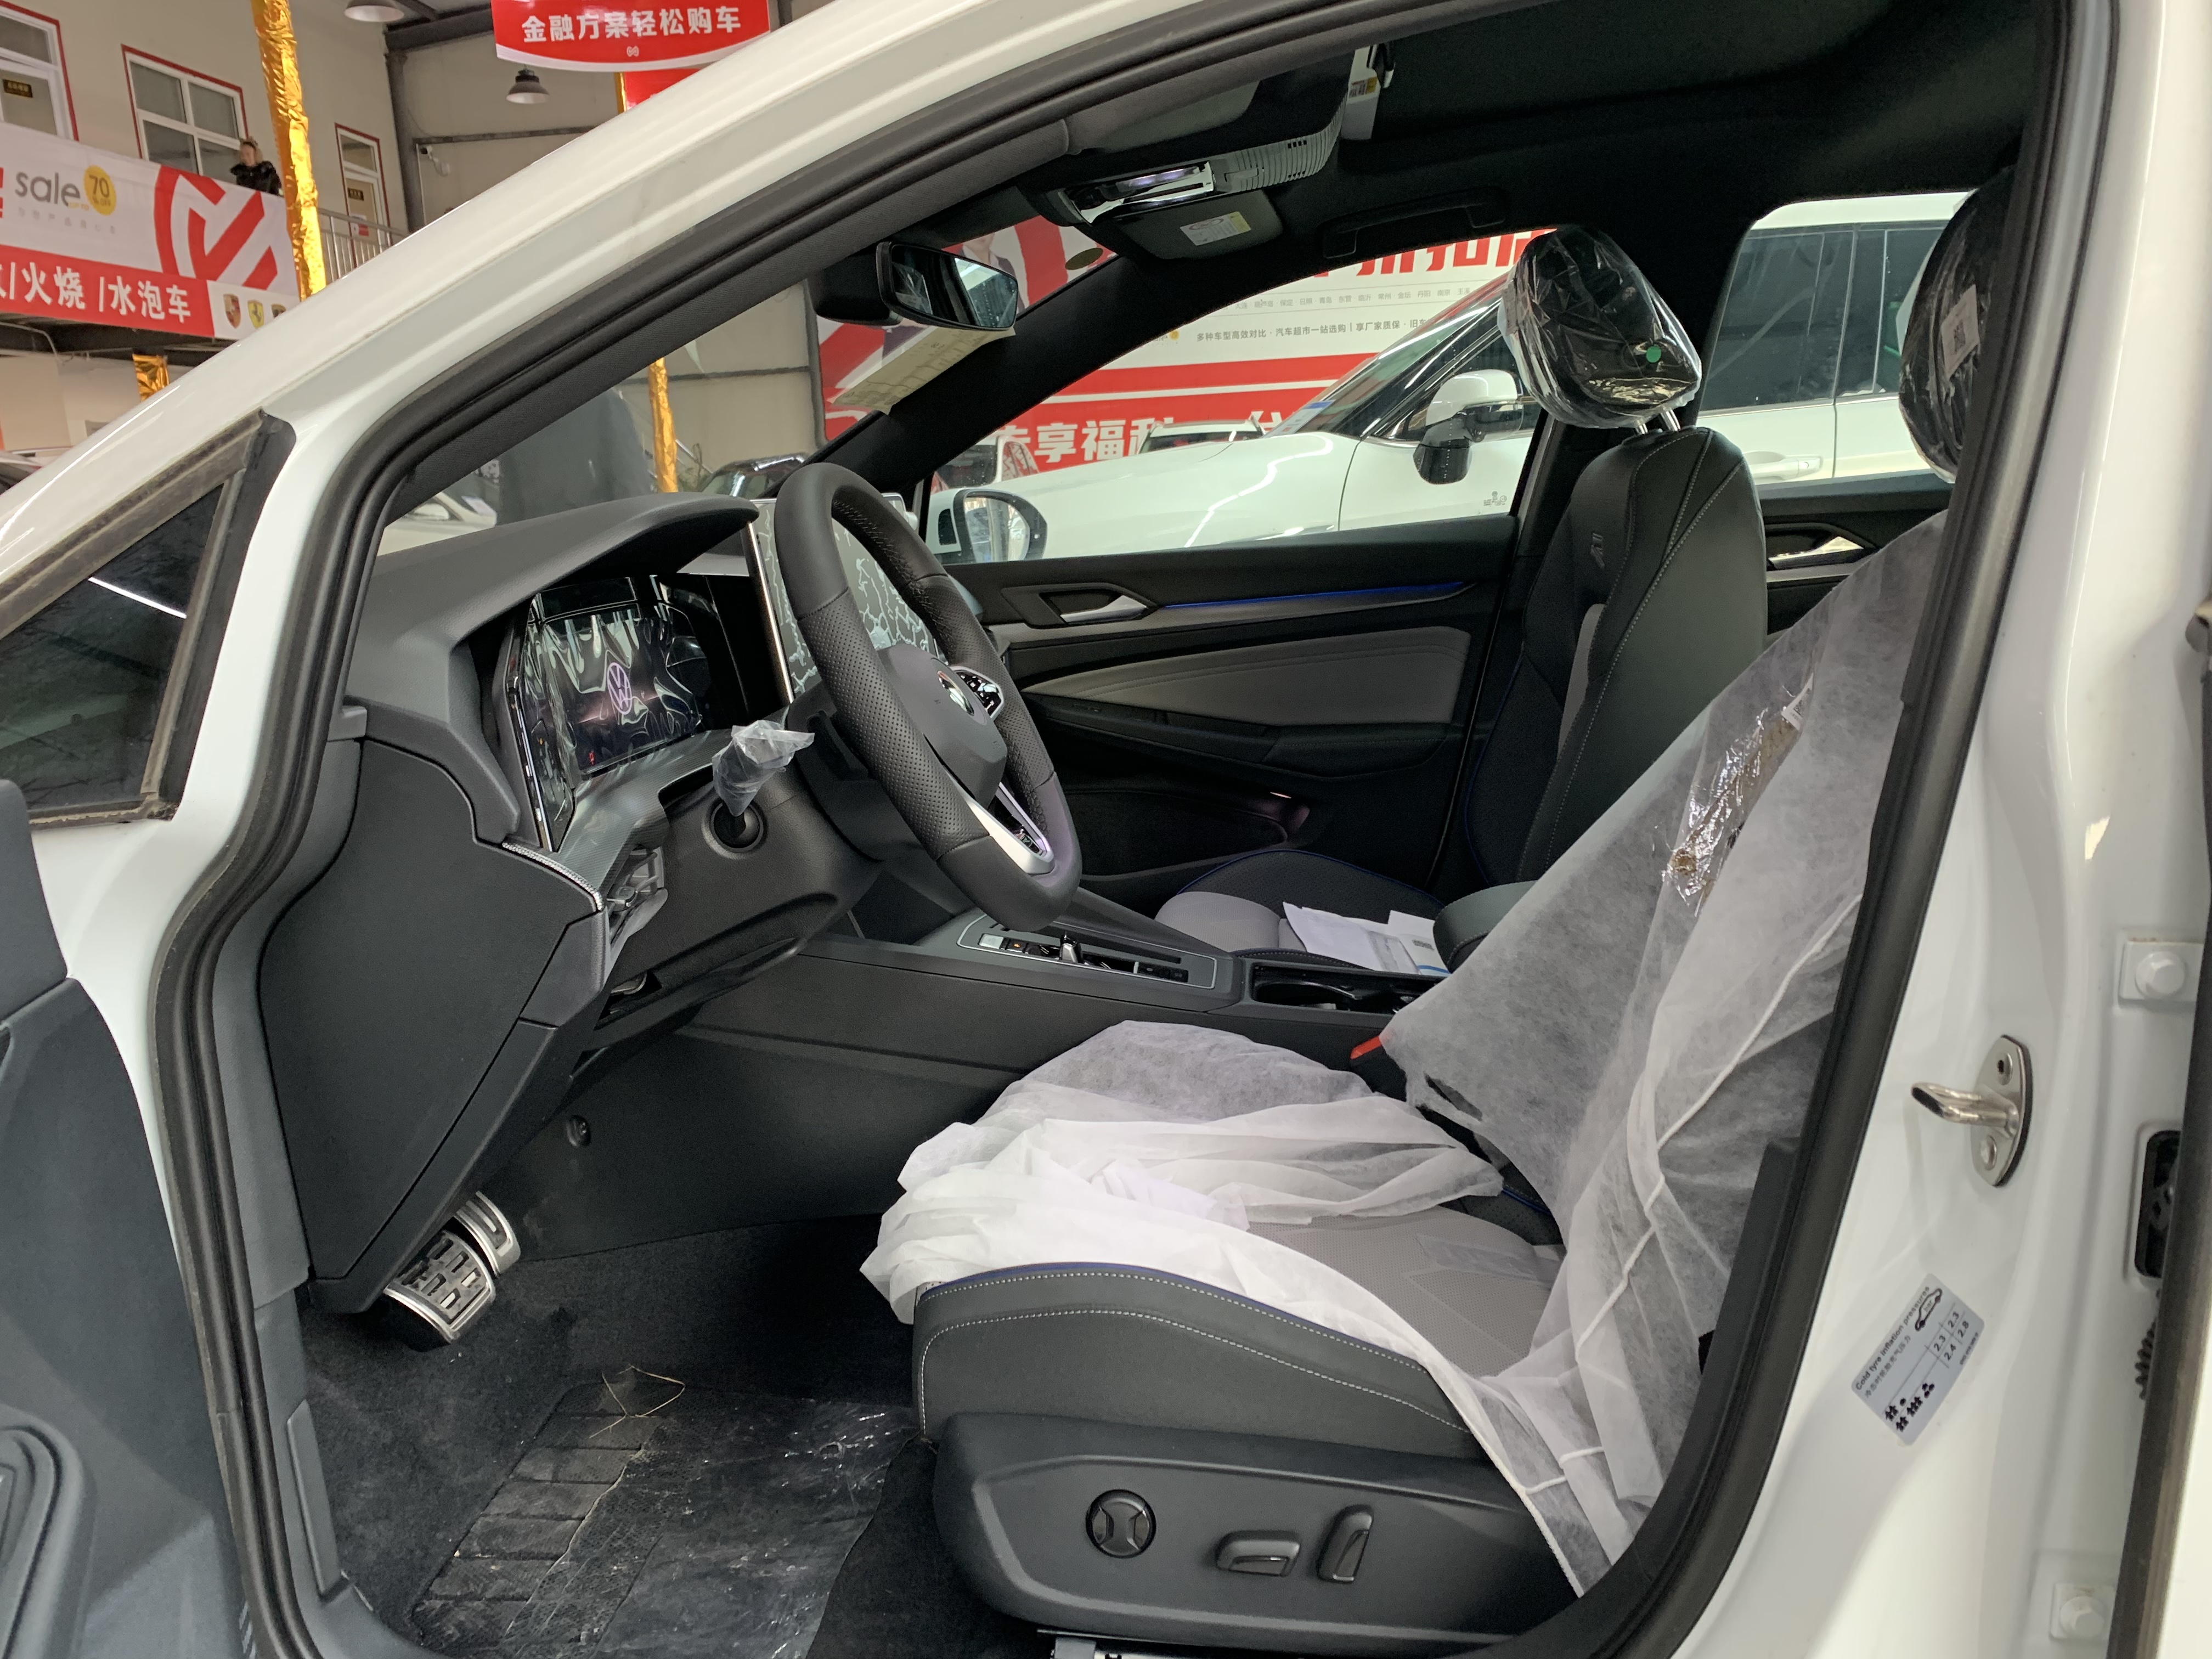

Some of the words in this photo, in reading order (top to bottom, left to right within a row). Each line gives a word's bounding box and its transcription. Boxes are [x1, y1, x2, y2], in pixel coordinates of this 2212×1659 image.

[522, 6, 741, 43] 金融方案轻松购车
[15, 172, 80, 207] sale
[89, 174, 110, 198] 70
[1197, 329, 1266, 342] 多种车型高效对比
[1276, 324, 1346, 336] 汽车超市一站选购
[1356, 320, 1400, 332] 享厂家质保
[1923, 1300, 1932, 1312] bar
[1856, 1371, 1871, 1390] Cold
[1869, 1356, 1882, 1372] tyre
[1904, 1286, 1929, 1325] pressures
[1934, 1335, 1945, 1352] 2.3
[1948, 1311, 1959, 1328] 2.3
[1944, 1344, 1956, 1361] 2.4
[1957, 1321, 1969, 1338] 2.8
